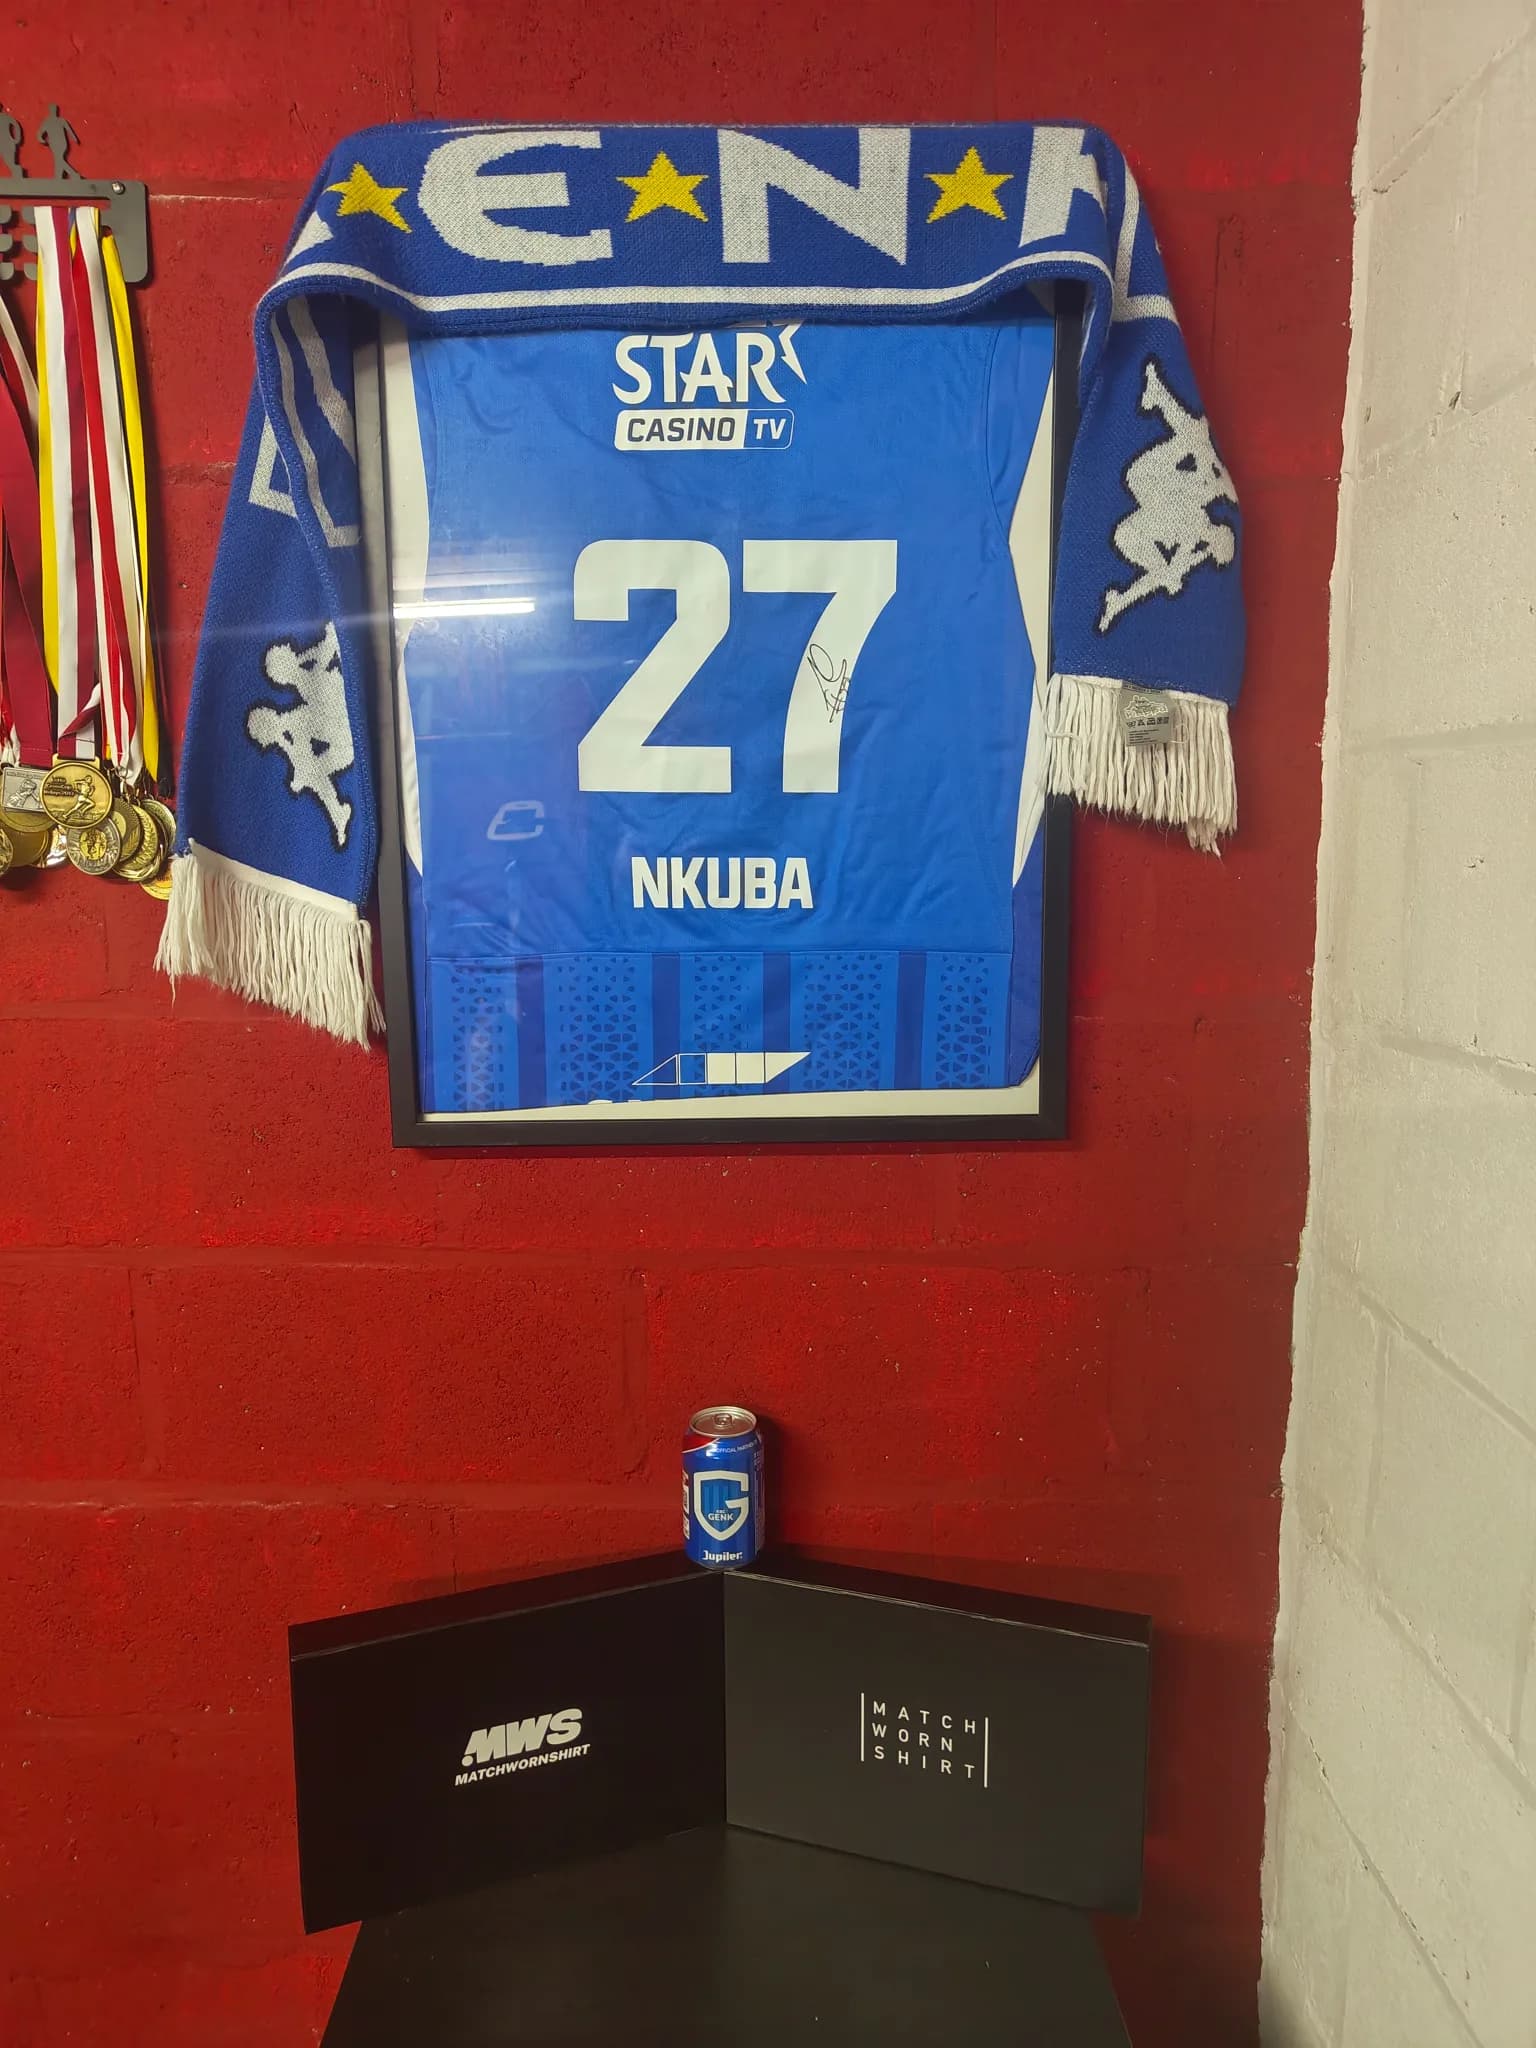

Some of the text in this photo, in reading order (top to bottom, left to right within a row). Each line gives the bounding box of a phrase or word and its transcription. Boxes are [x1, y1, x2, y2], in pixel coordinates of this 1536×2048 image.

[612, 333, 787, 404] STAR
[627, 417, 786, 442] CASINO TV
[573, 539, 898, 793] 27
[631, 856, 814, 909] NKUBA
[707, 1512, 734, 1521] GENK
[702, 1550, 742, 1563] Jupiler
[873, 1701, 976, 1735] MATCH
[872, 1722, 953, 1752] WORN
[454, 1744, 591, 1786] MATCHWORNSHIRT
[874, 1745, 975, 1779] SHIRT
